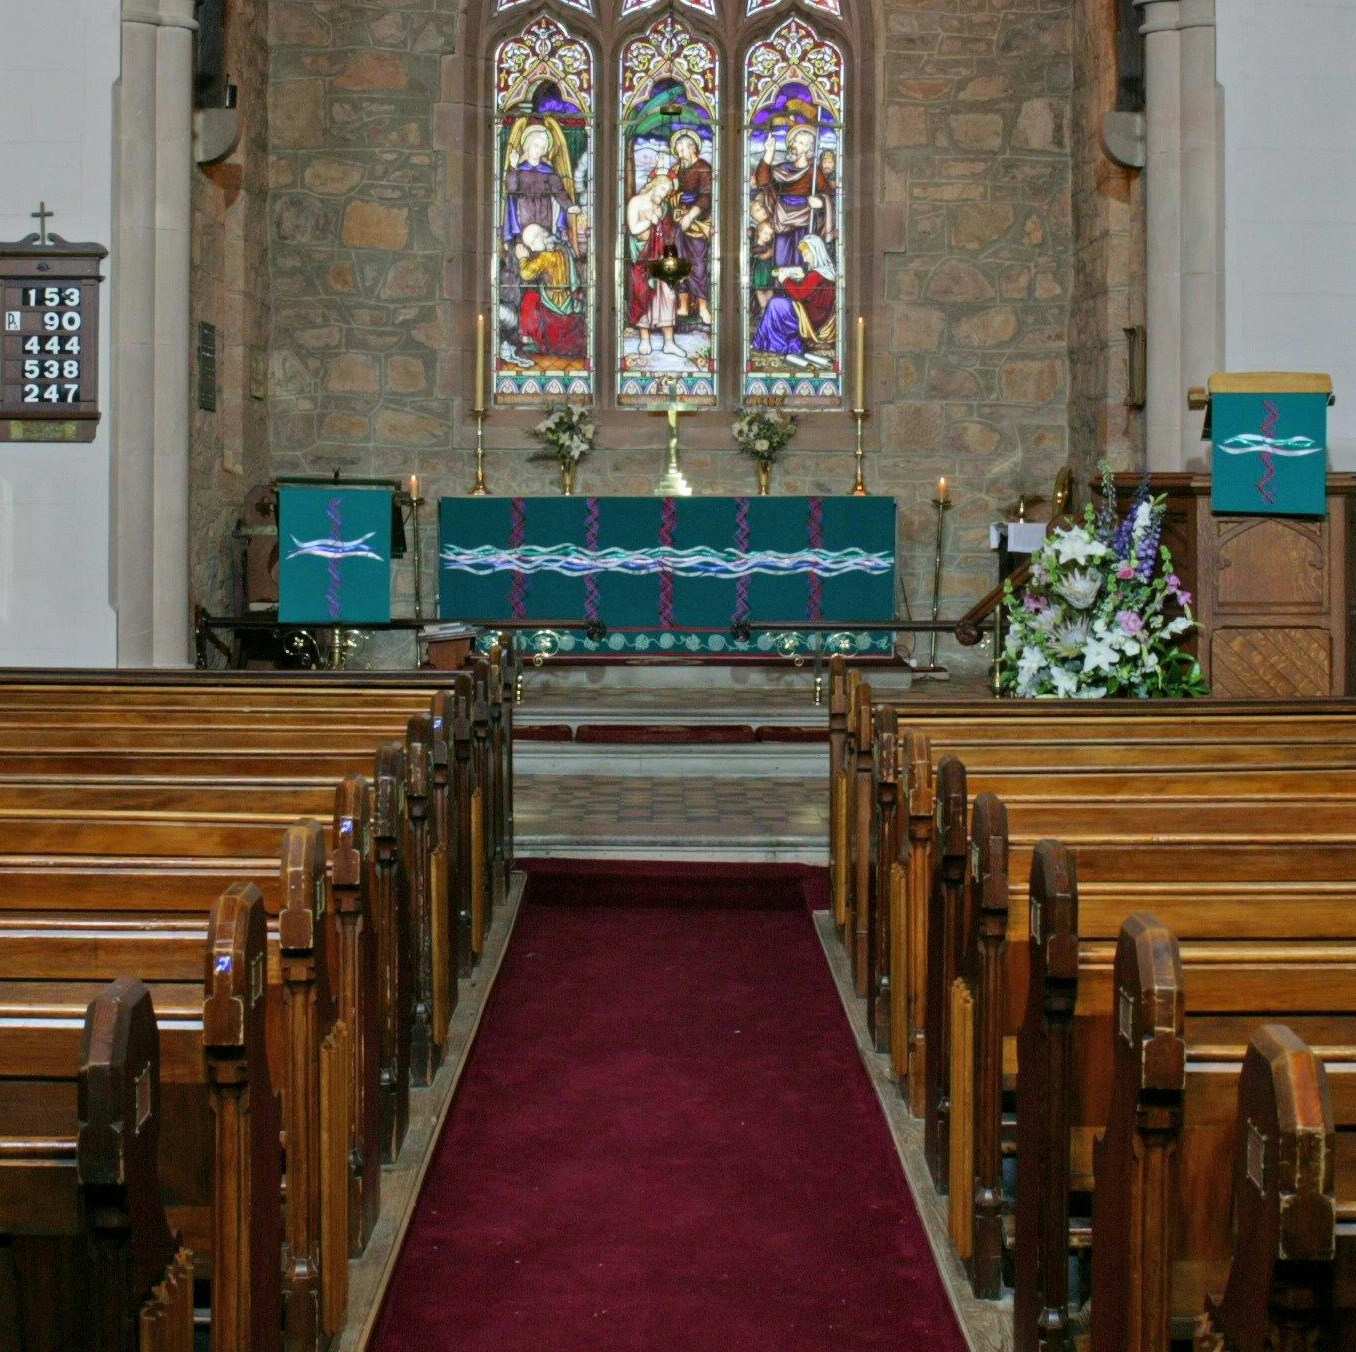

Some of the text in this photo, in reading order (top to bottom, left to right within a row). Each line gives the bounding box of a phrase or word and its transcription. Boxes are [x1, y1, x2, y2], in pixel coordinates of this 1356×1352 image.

[28, 287, 80, 307] 153
[44, 311, 81, 331] 90
[24, 335, 80, 355] 444
[24, 359, 79, 379] 538
[23, 383, 79, 403] 247
